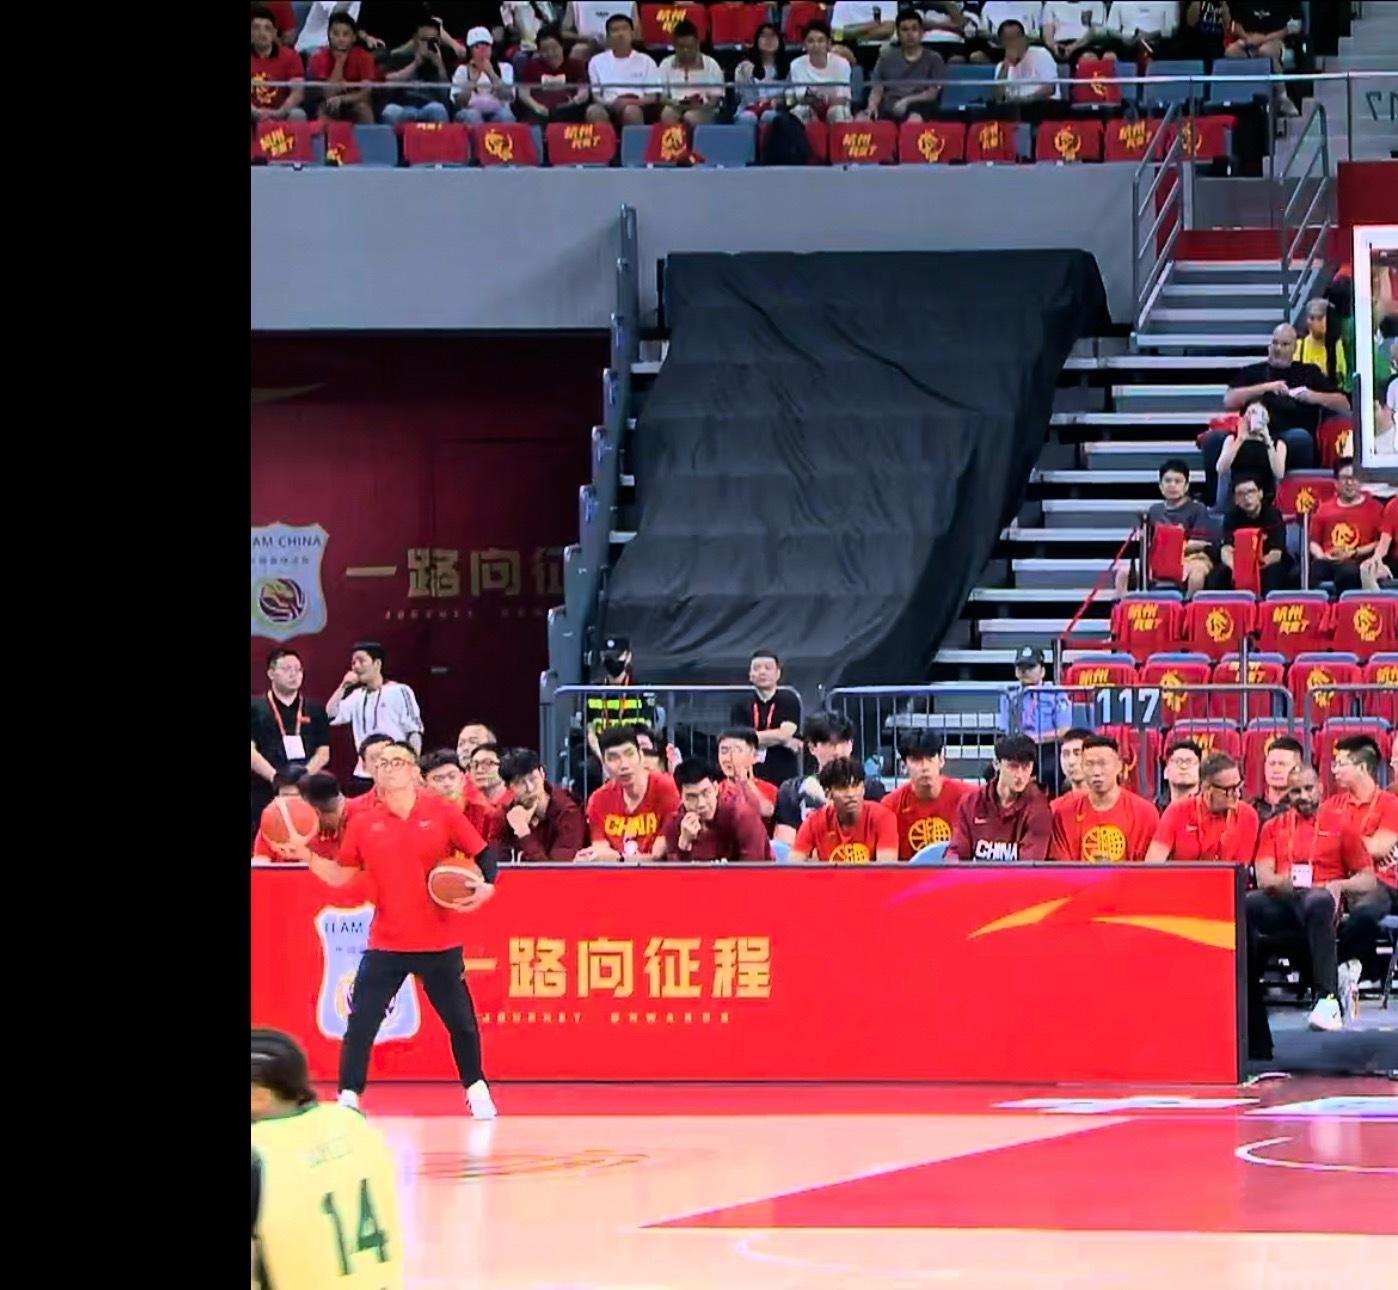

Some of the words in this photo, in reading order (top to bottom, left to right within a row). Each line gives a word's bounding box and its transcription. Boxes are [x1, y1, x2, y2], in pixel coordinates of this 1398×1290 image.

[279, 536, 322, 549] CHINA
[1097, 688, 1159, 723] 117
[975, 839, 1018, 861] CHINA
[465, 937, 772, 999] 一路向征程
[321, 1178, 390, 1276] 14
